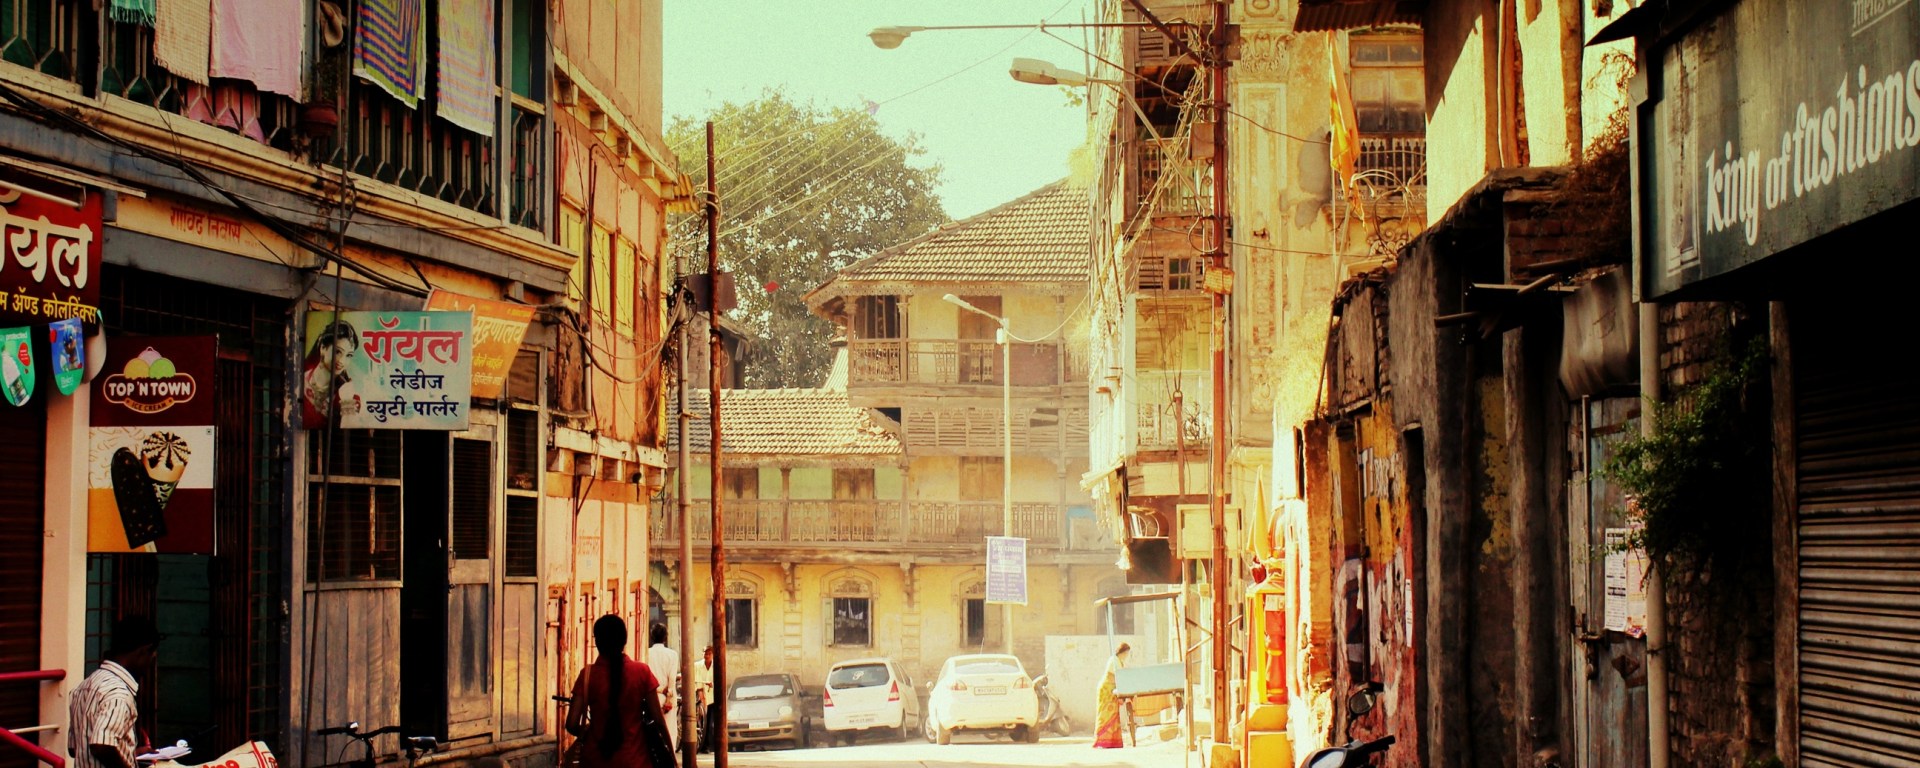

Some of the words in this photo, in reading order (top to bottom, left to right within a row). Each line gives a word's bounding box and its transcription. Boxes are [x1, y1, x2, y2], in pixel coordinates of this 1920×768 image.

[1705, 140, 1760, 246] king
[1765, 131, 1792, 210] of
[1790, 59, 1920, 198] fashions
[362, 317, 464, 365] रॉयल
[108, 382, 135, 397] TOP
[136, 380, 148, 397] 'N
[149, 382, 191, 397] TOWN
[389, 368, 444, 390] लेडीज
[131, 401, 142, 411] ICE
[144, 402, 167, 412] CREAM
[365, 395, 407, 423] ब्युटी
[412, 395, 459, 417] पार्लर
